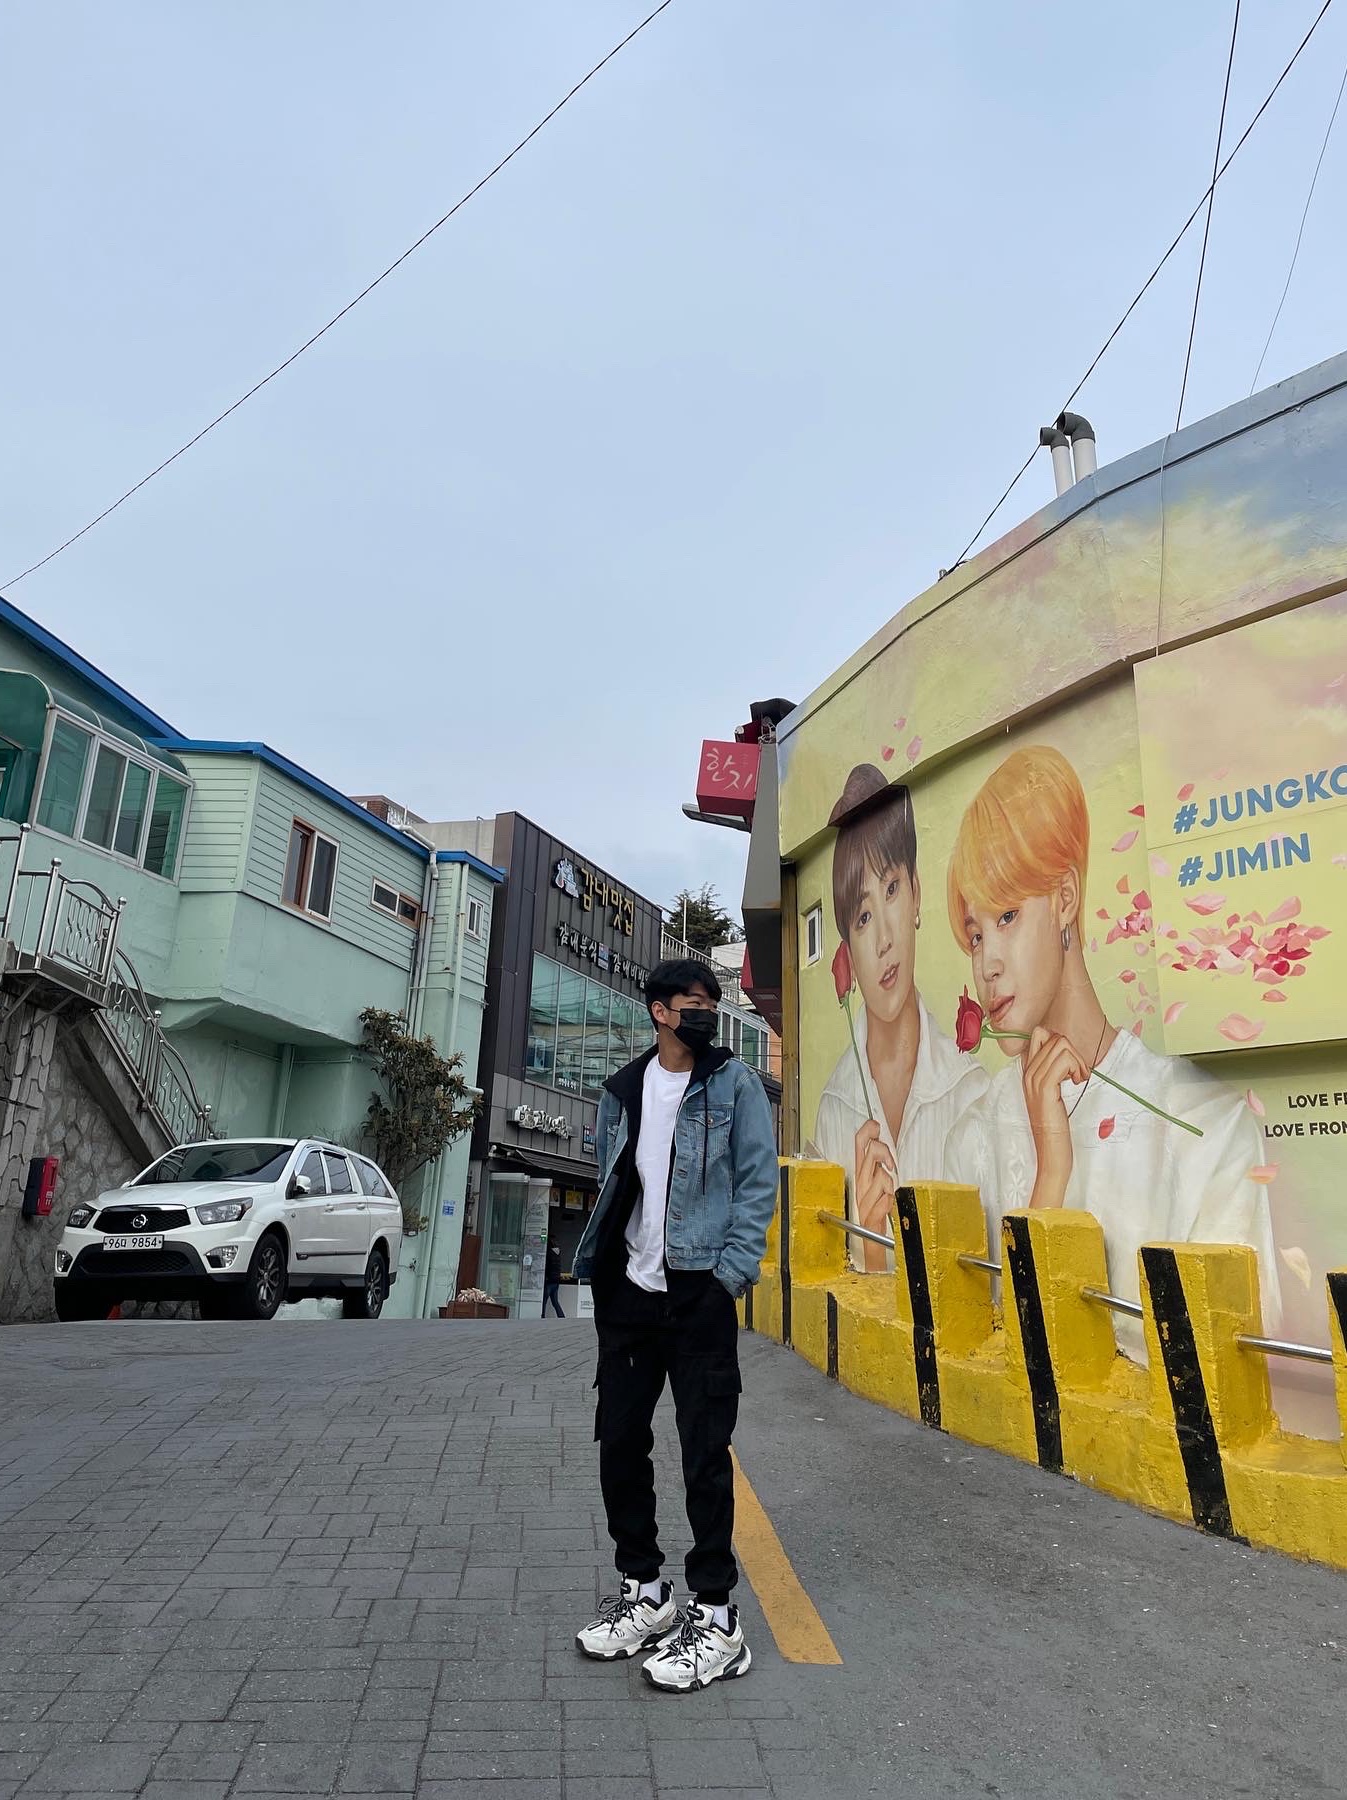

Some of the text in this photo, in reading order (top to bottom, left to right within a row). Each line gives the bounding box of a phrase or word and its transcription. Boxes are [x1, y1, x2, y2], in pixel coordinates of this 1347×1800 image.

[1178, 833, 1311, 887] #JIMIN
[581, 868, 634, 936] 감내맛집
[1288, 1094, 1329, 1108] LOVE
[1264, 1123, 1304, 1138] LOVE
[131, 1237, 157, 1247] 9854
